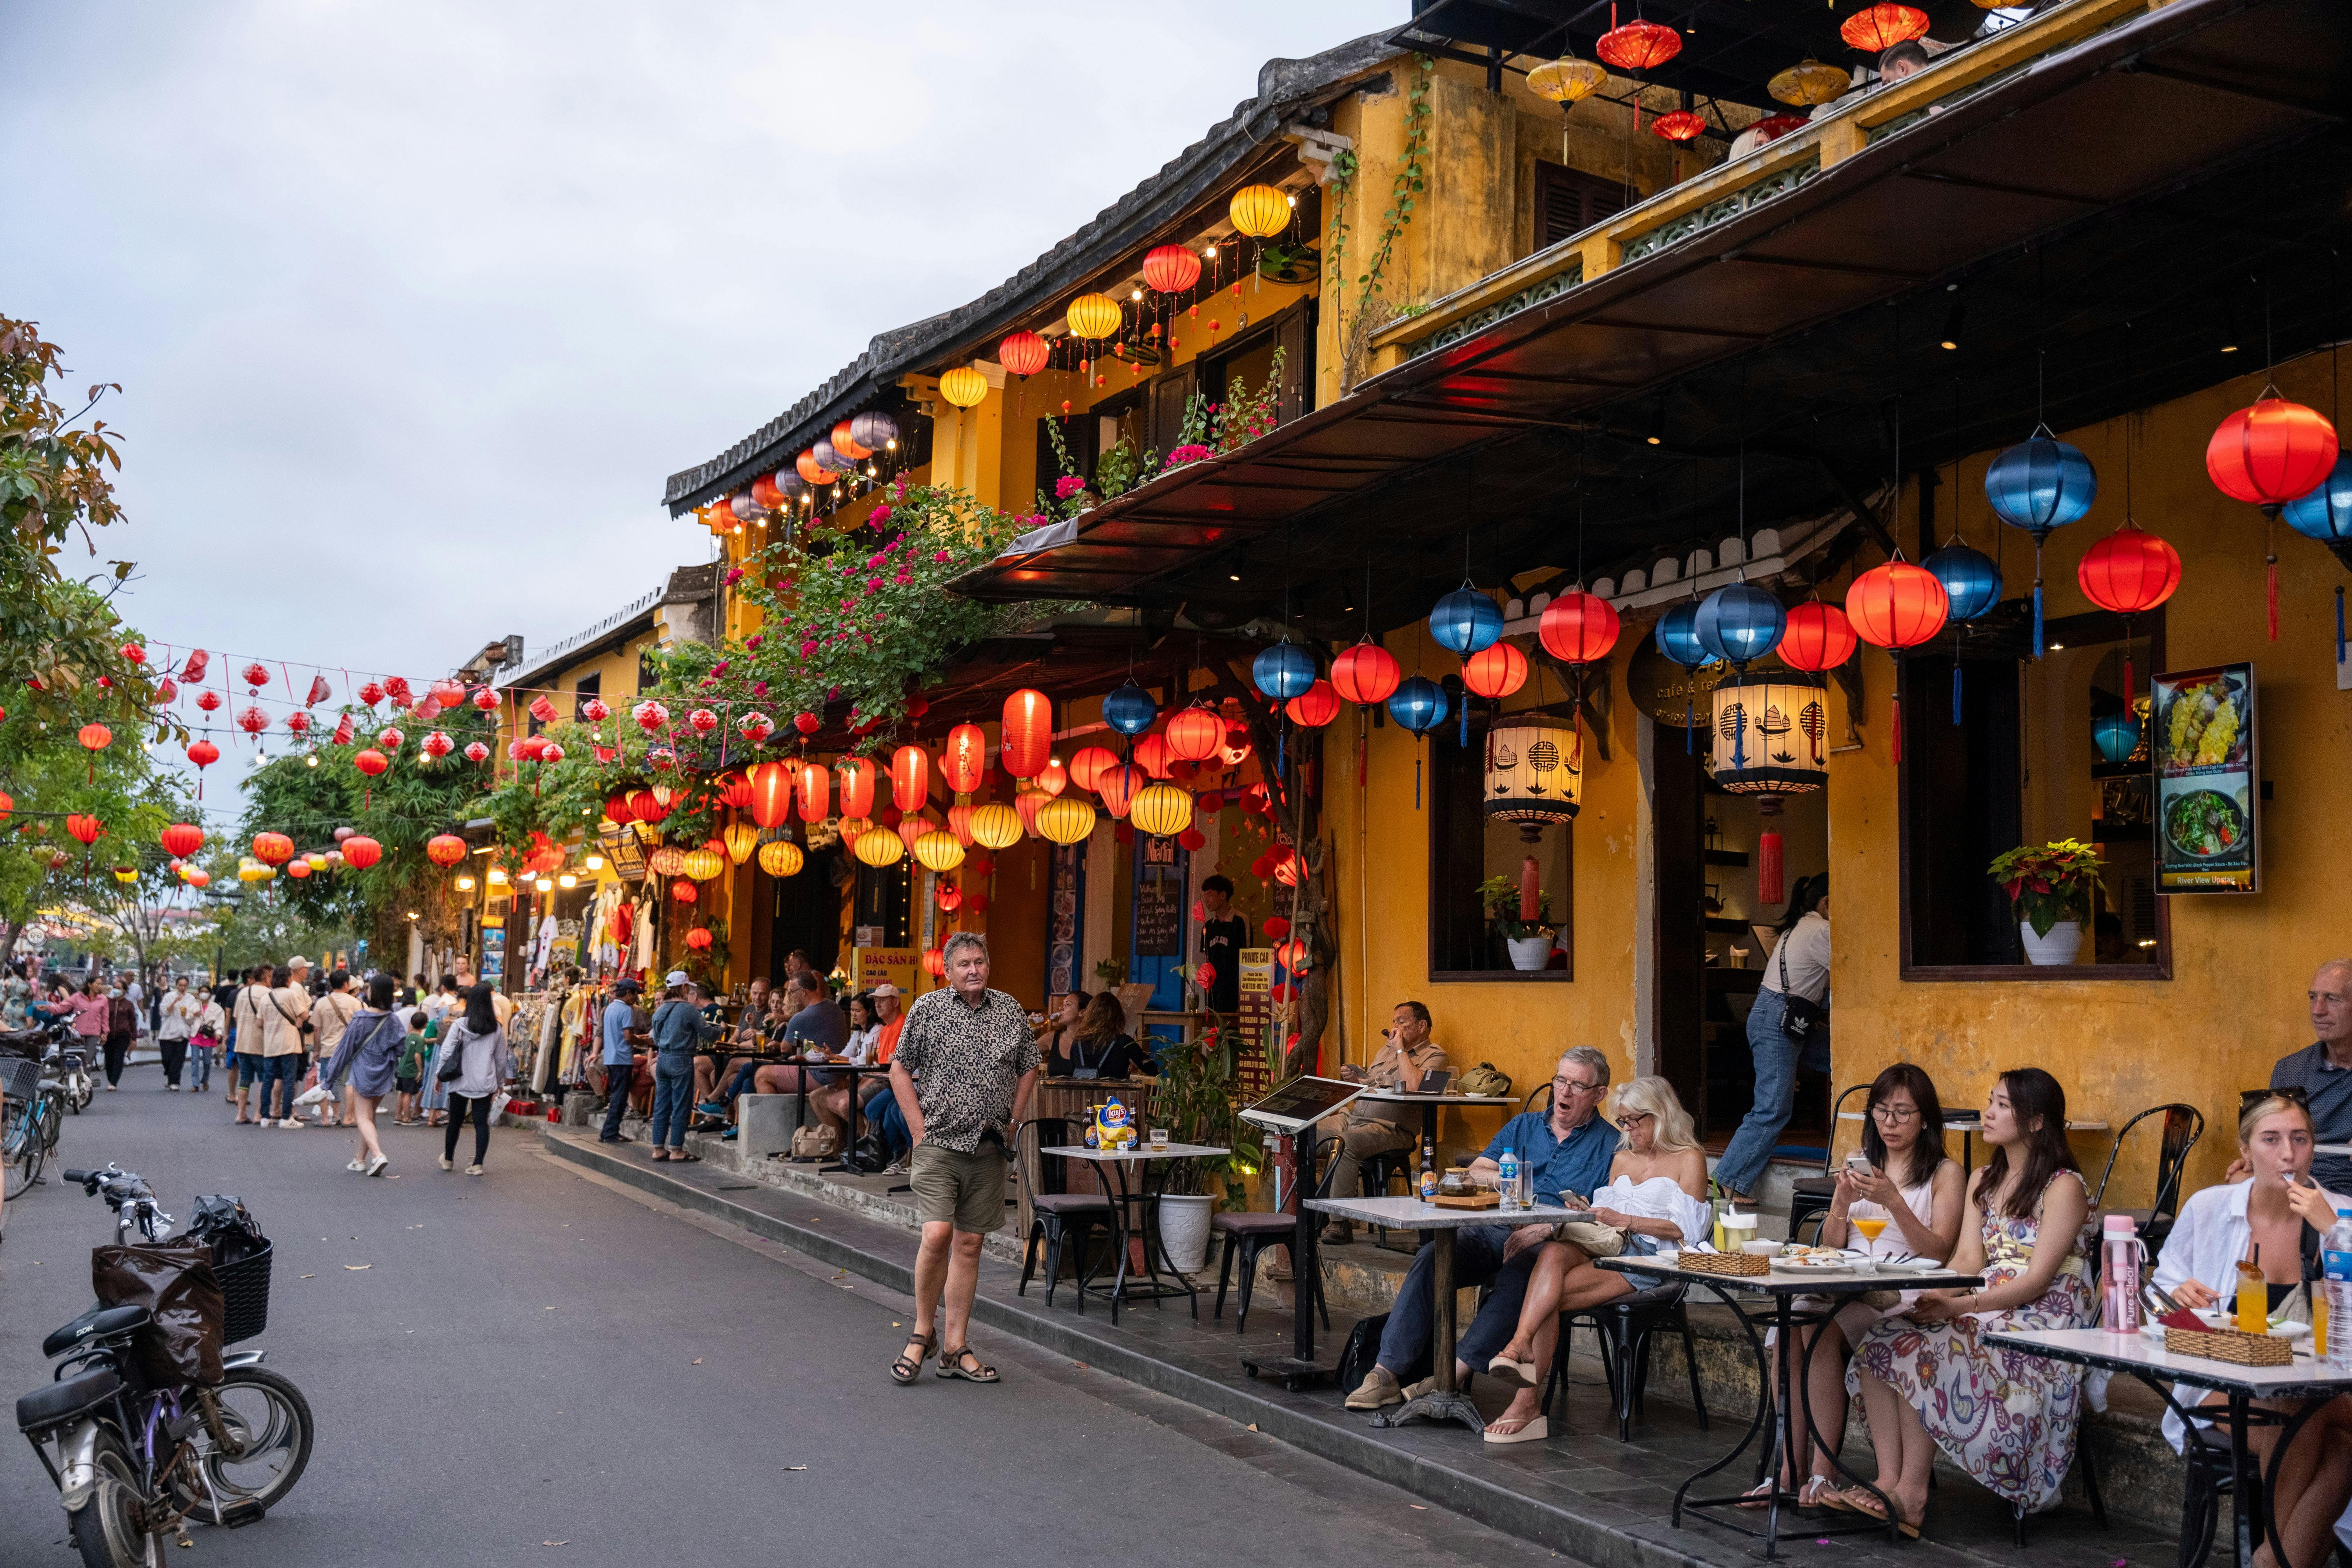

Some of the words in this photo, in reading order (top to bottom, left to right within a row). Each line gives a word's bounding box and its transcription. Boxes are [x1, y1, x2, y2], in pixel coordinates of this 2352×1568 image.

[1657, 684, 1683, 698] cafe
[1688, 681, 1695, 693] &
[2212, 876, 2235, 885] Upstair
[865, 953, 885, 967] ĐẶC
[887, 952, 906, 964] SẢN
[1242, 952, 1259, 963] PRIVATE
[1260, 952, 1269, 963] CAR
[1790, 1025, 1805, 1035] adidas
[1108, 1107, 1124, 1119] Lay's
[1422, 1183, 1437, 1192] LARUE
[2125, 1265, 2134, 1296] Clear
[76, 1324, 94, 1337] DDK
